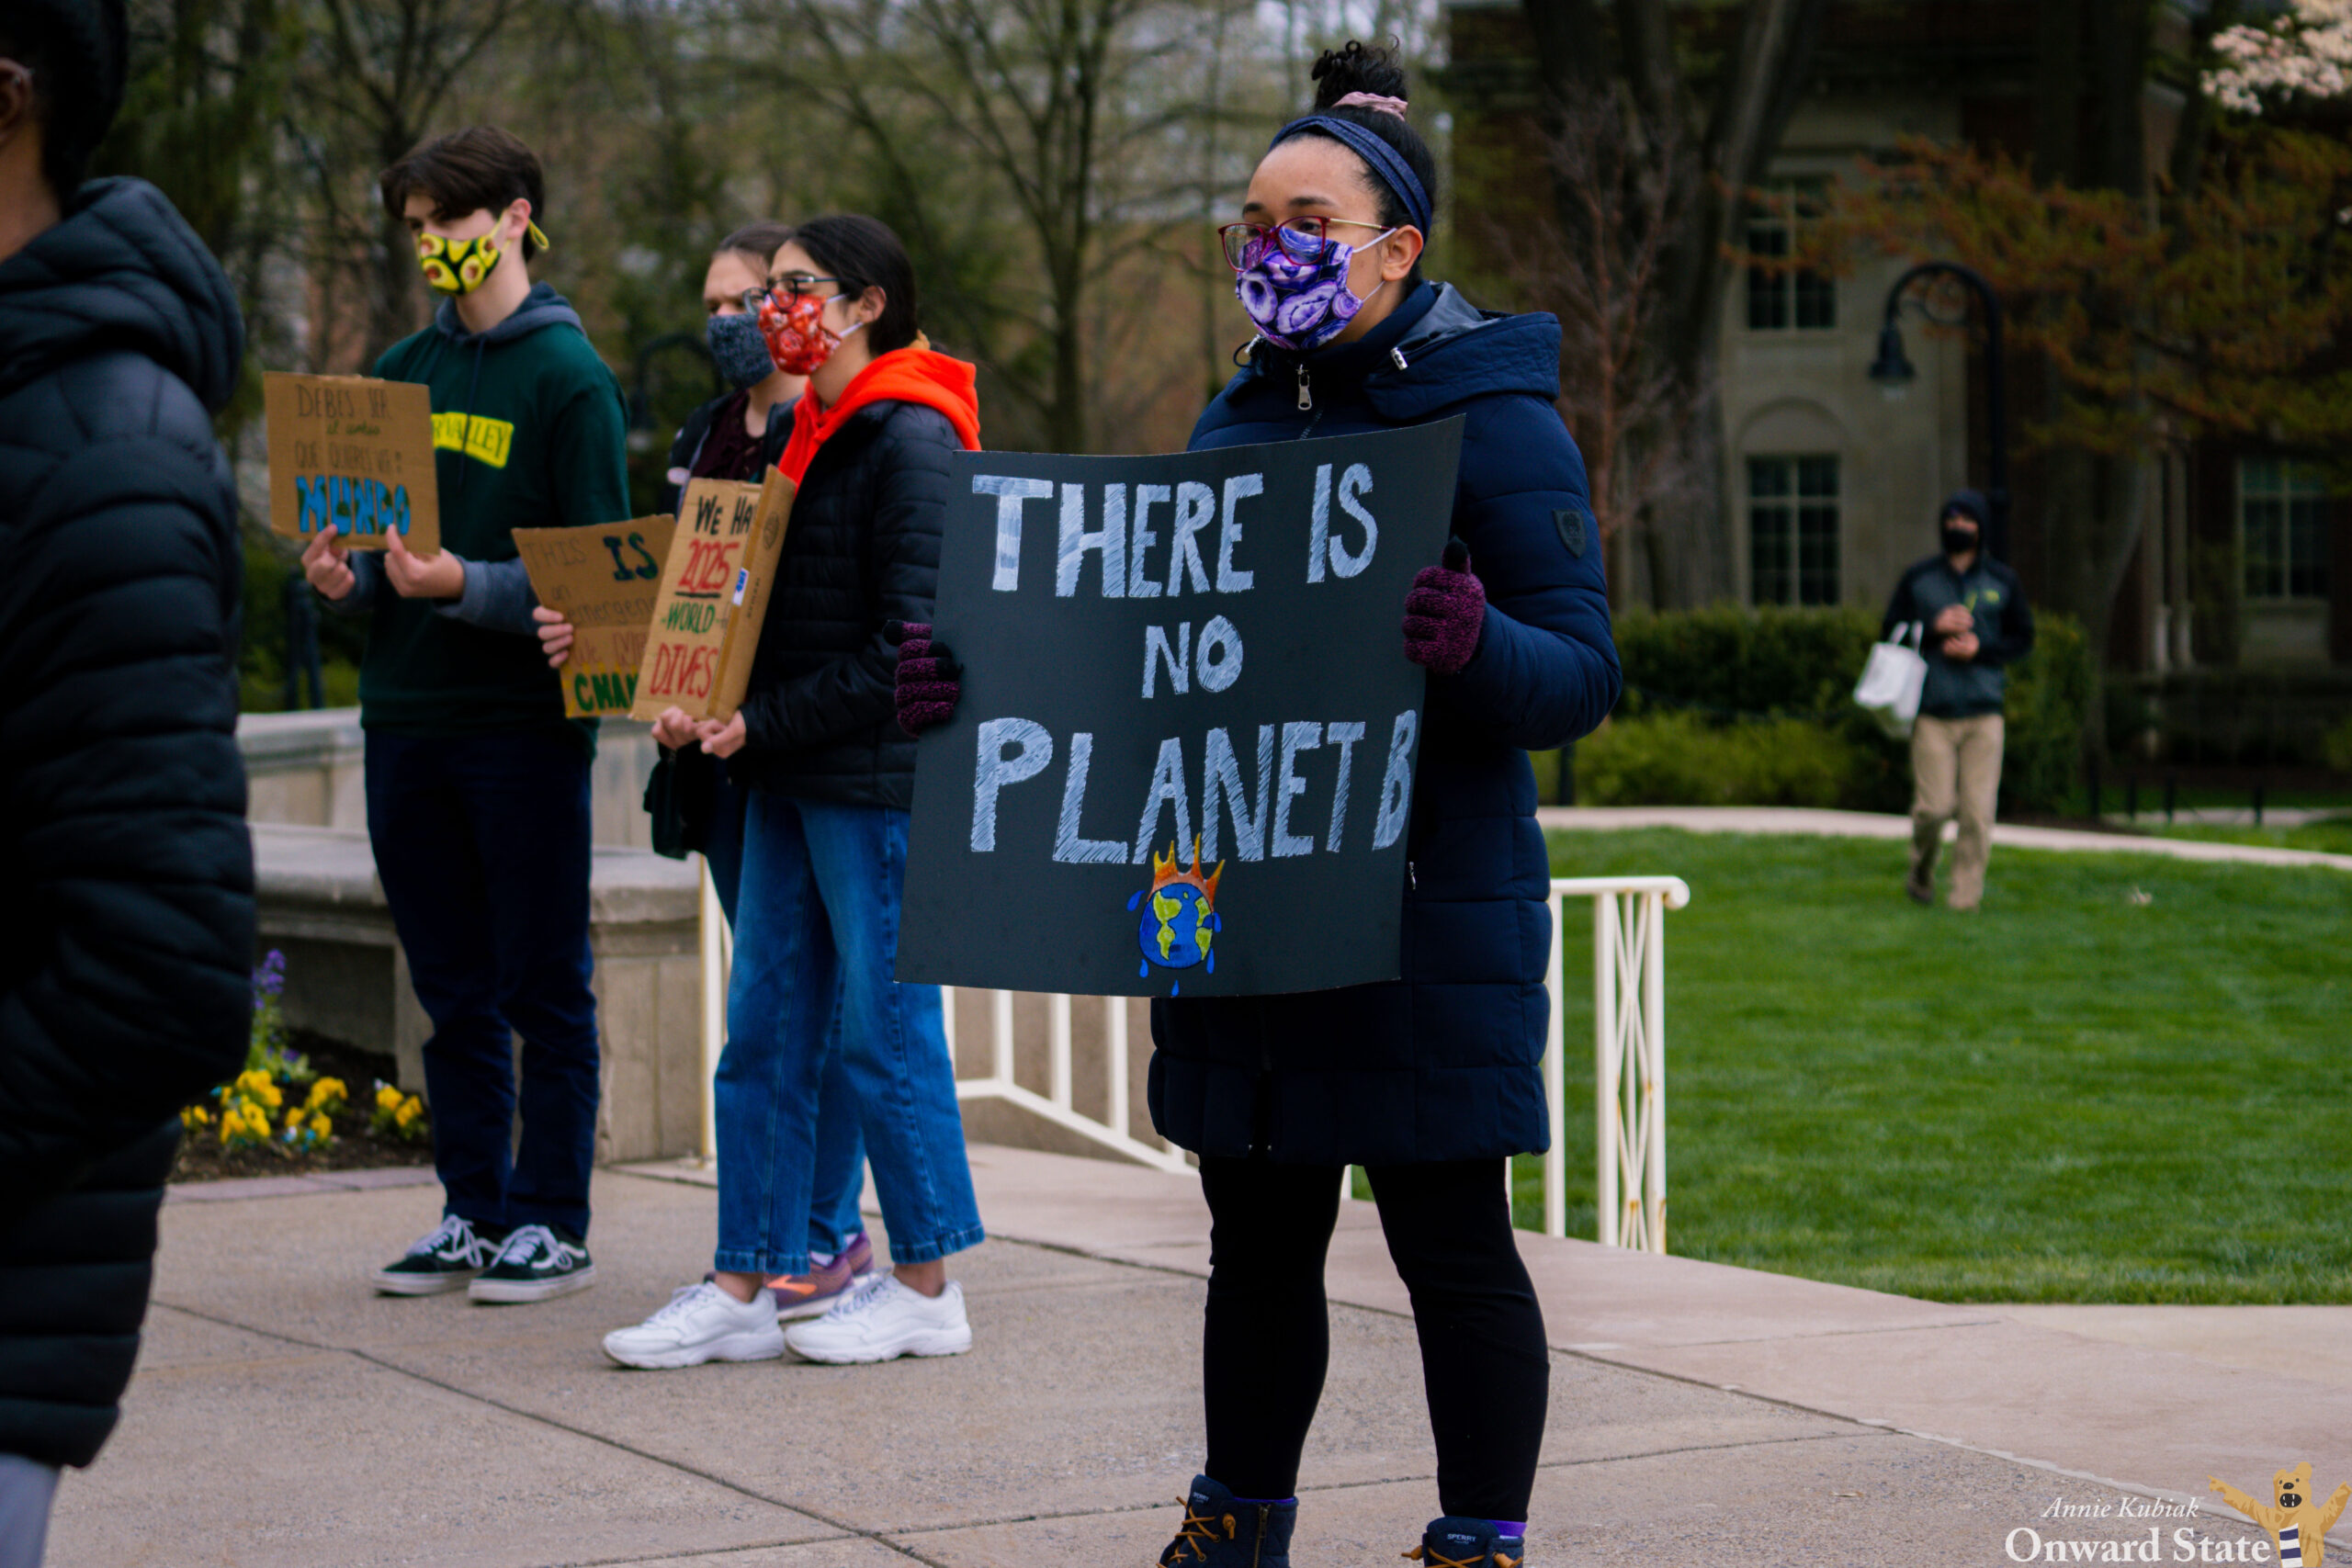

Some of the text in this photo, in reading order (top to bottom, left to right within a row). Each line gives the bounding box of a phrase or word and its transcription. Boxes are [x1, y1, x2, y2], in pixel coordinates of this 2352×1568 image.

[297, 384, 354, 418] DEBES
[296, 475, 412, 536] MUNDO
[695, 494, 754, 536] WE HA
[972, 462, 1379, 599] THERE IS
[521, 532, 659, 581] THIS IS
[679, 538, 740, 593] 2025
[666, 602, 716, 634] WORLD
[650, 643, 718, 699] DIVES
[1142, 615, 1244, 699] NO
[970, 709, 1419, 865] PLANET B
